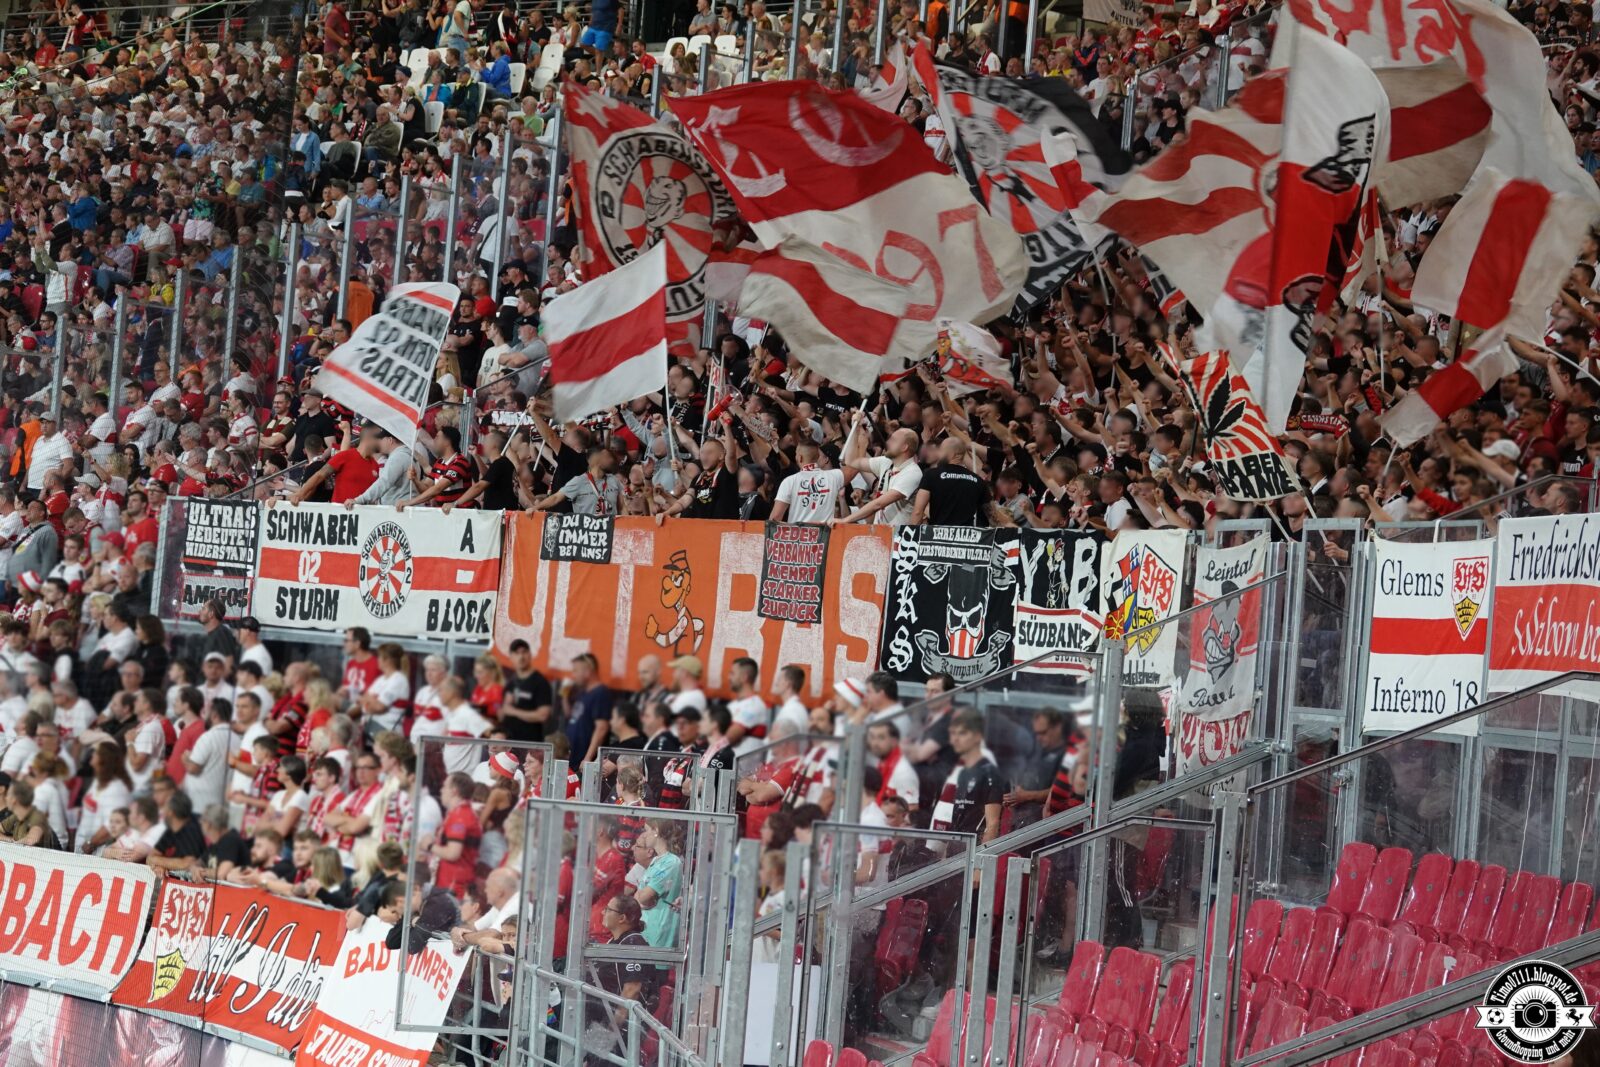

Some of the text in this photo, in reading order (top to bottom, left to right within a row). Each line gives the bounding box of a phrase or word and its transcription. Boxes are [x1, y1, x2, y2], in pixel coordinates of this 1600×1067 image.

[940, 471, 978, 483] Commando
[187, 502, 257, 529] ULTRAS
[266, 509, 359, 546] SCHWABEN
[562, 514, 609, 530] DU BIST
[186, 524, 255, 547] BEDEUTET
[361, 523, 412, 562] SCHWABENSTURM
[460, 518, 475, 553] A
[558, 529, 608, 547] IMMER
[773, 525, 820, 543] JEDER
[932, 527, 982, 543] EHRE ALLEN
[185, 541, 254, 563] WIDERSTAND
[558, 545, 608, 560] BEI UNS!
[766, 538, 825, 565] VERBANNTE
[1203, 548, 1257, 581] Leintal
[297, 551, 321, 584] 02
[768, 562, 817, 583] KEHRT
[1380, 558, 1444, 597] Glems
[275, 585, 339, 622] STURM
[362, 591, 405, 617] STUTTGART
[426, 598, 491, 634] BLOCK
[1371, 676, 1446, 714] Inferno
[344, 941, 392, 979] BAD
